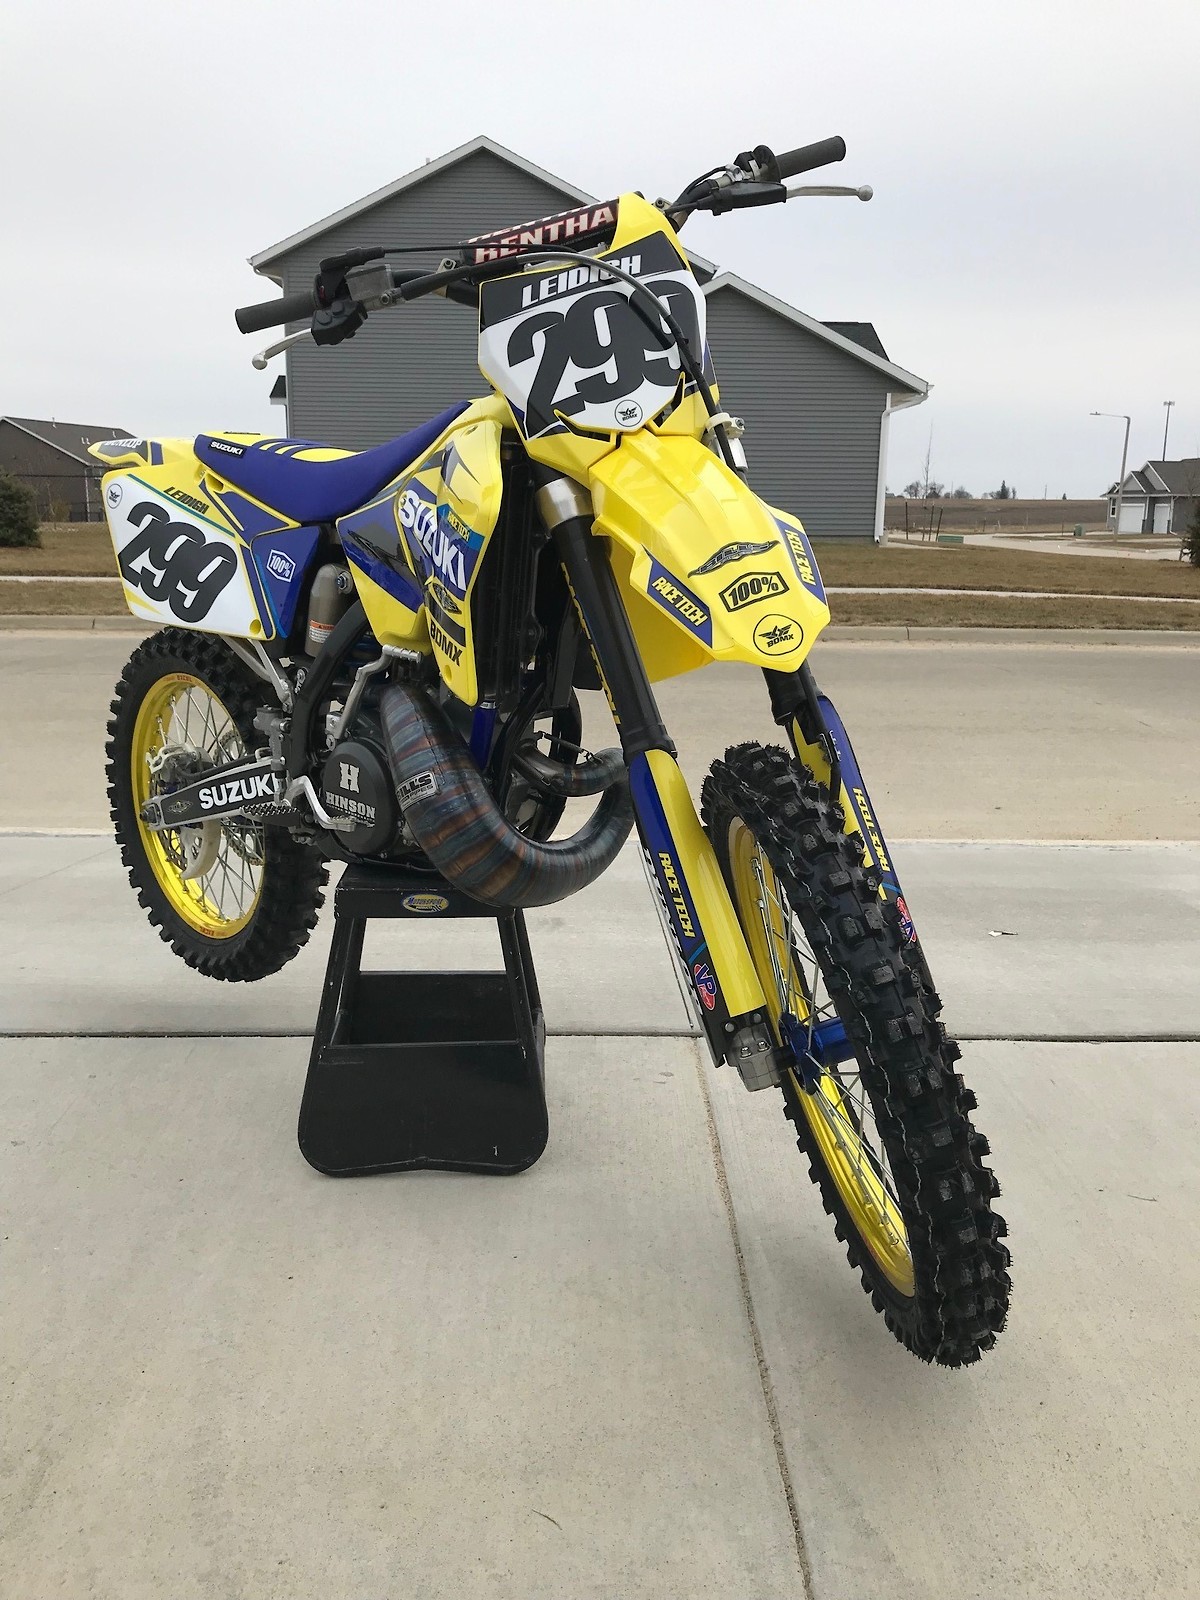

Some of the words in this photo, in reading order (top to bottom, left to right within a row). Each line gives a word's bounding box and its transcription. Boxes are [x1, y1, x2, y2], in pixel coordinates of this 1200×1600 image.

[507, 279, 701, 439] 299
[210, 441, 244, 456] SUZUKI
[163, 486, 210, 515] LEIDIGH
[398, 489, 467, 591] SUZUKI
[118, 501, 238, 623] 299
[270, 555, 292, 577] 100%
[728, 575, 780, 607] 100%
[429, 617, 463, 667] BDMX
[766, 633, 794, 648] BDMX
[198, 772, 279, 810] SUZUKI
[325, 791, 376, 819] HINSON
[695, 963, 717, 996] VP
